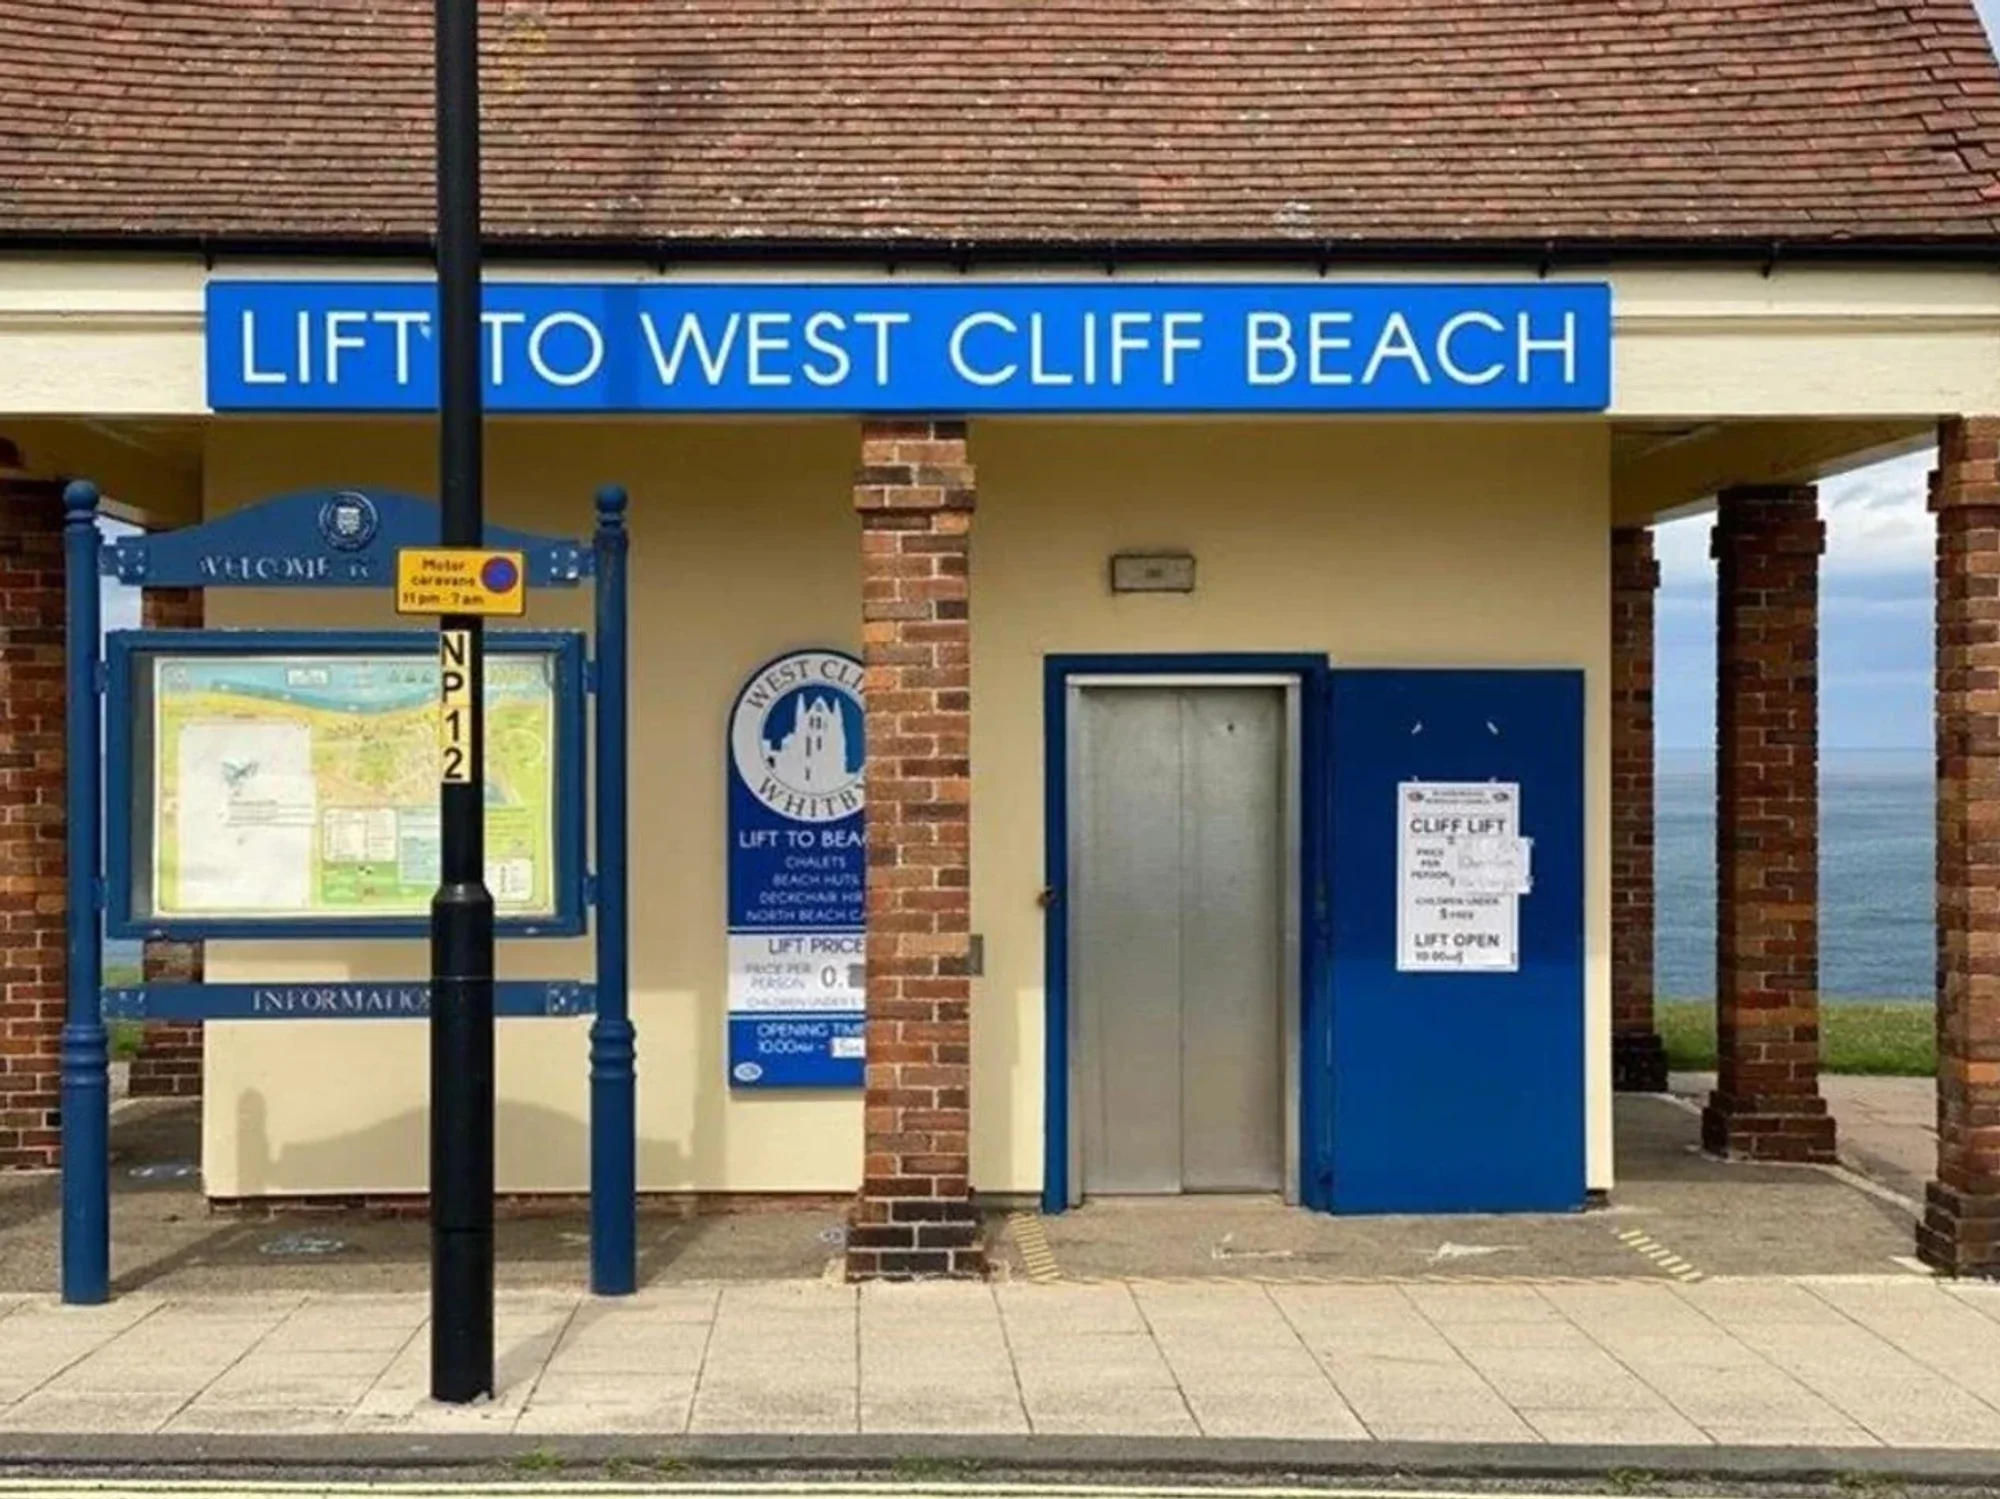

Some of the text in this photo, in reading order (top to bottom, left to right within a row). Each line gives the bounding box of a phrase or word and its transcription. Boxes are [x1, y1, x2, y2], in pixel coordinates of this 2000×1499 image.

[242, 311, 1577, 386] LIFT TO WEST CLIFF BEACH
[199, 556, 333, 580] WELCOME
[421, 558, 466, 572] Motor
[410, 575, 477, 587] caravans
[746, 659, 865, 709] WEST CLI
[1410, 818, 1507, 833] CLIFF LIFT
[738, 829, 865, 848] LIFT TO BEA
[784, 855, 847, 870] CHALETS
[772, 873, 861, 887] BEACH HUTS
[759, 890, 838, 905] DECKCHAIR
[744, 909, 796, 922] NORTH
[799, 909, 846, 922] BEACH
[768, 937, 806, 954] LIFT
[1414, 933, 1500, 948] LIFT OPEN
[757, 1023, 829, 1038] OPENING
